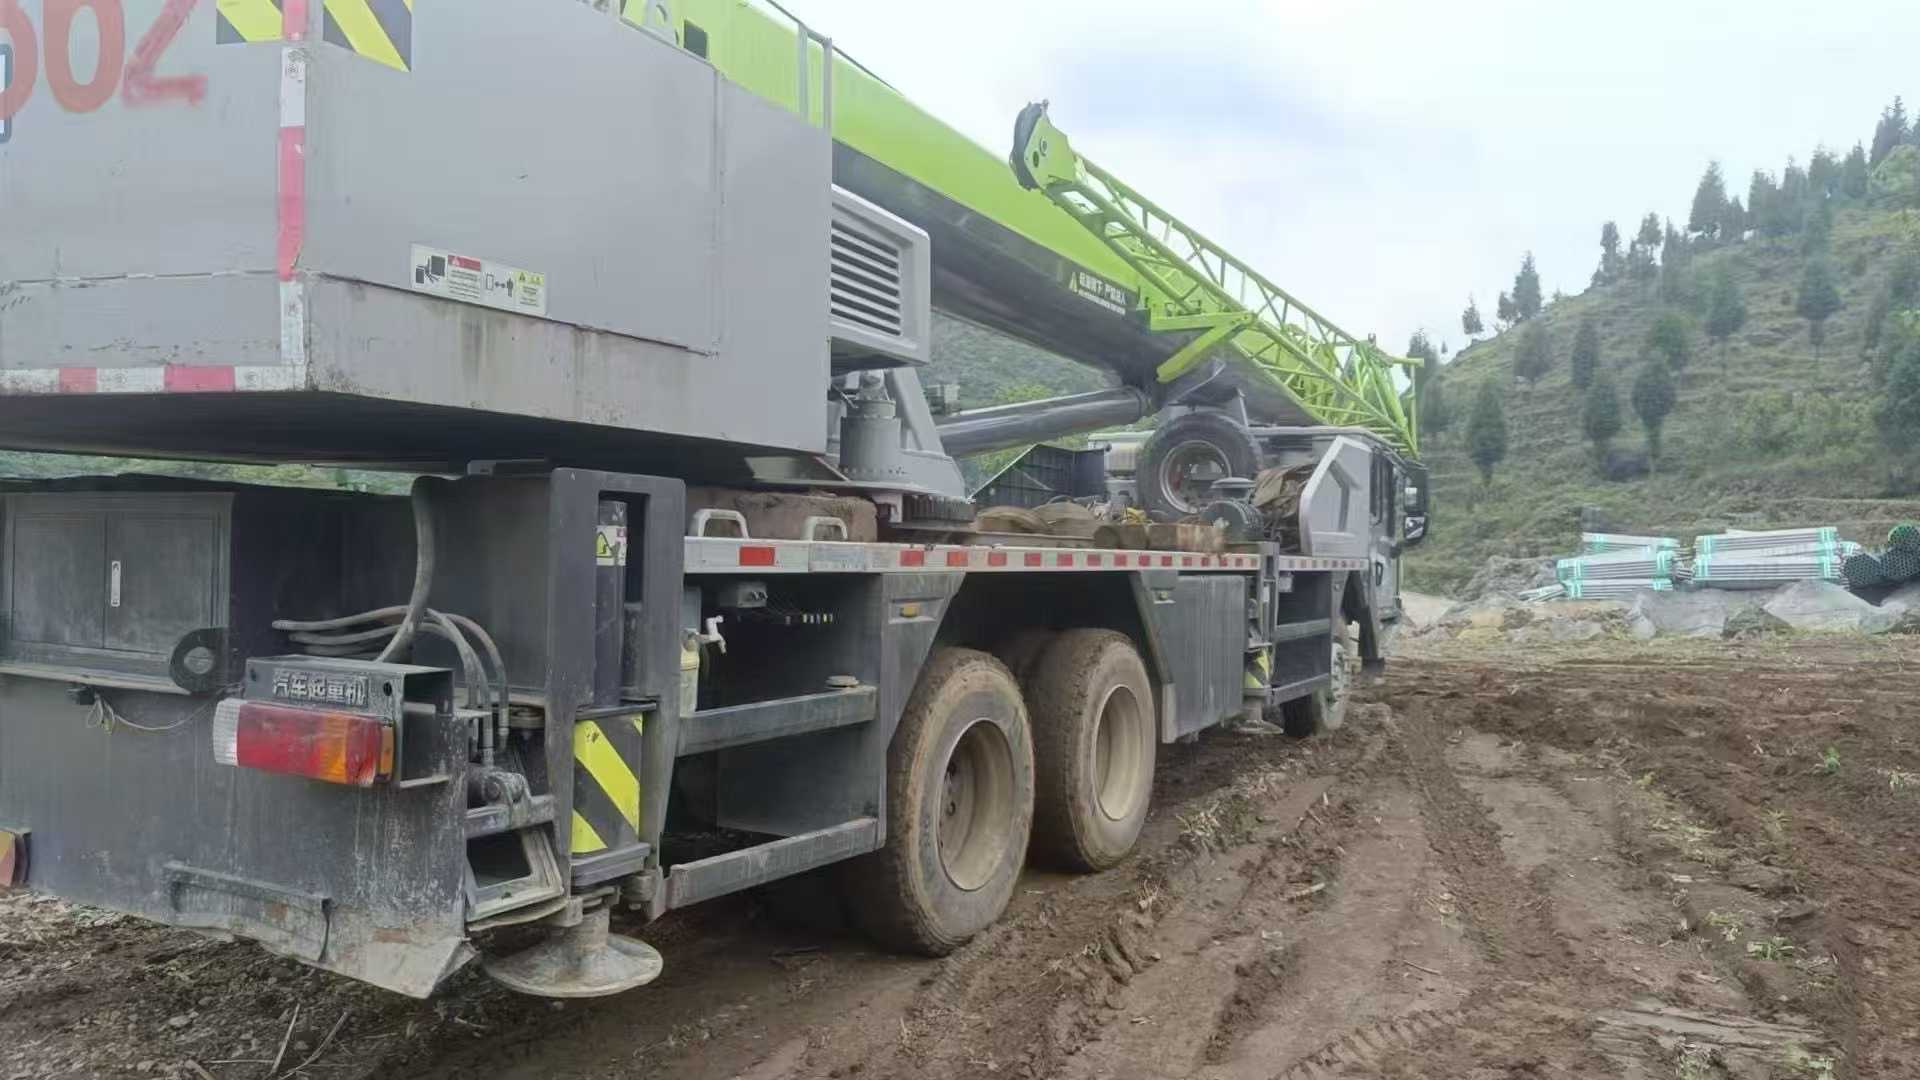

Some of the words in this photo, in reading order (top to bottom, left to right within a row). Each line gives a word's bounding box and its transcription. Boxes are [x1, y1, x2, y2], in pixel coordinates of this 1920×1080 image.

[272, 668, 369, 706] 汽车起重机
